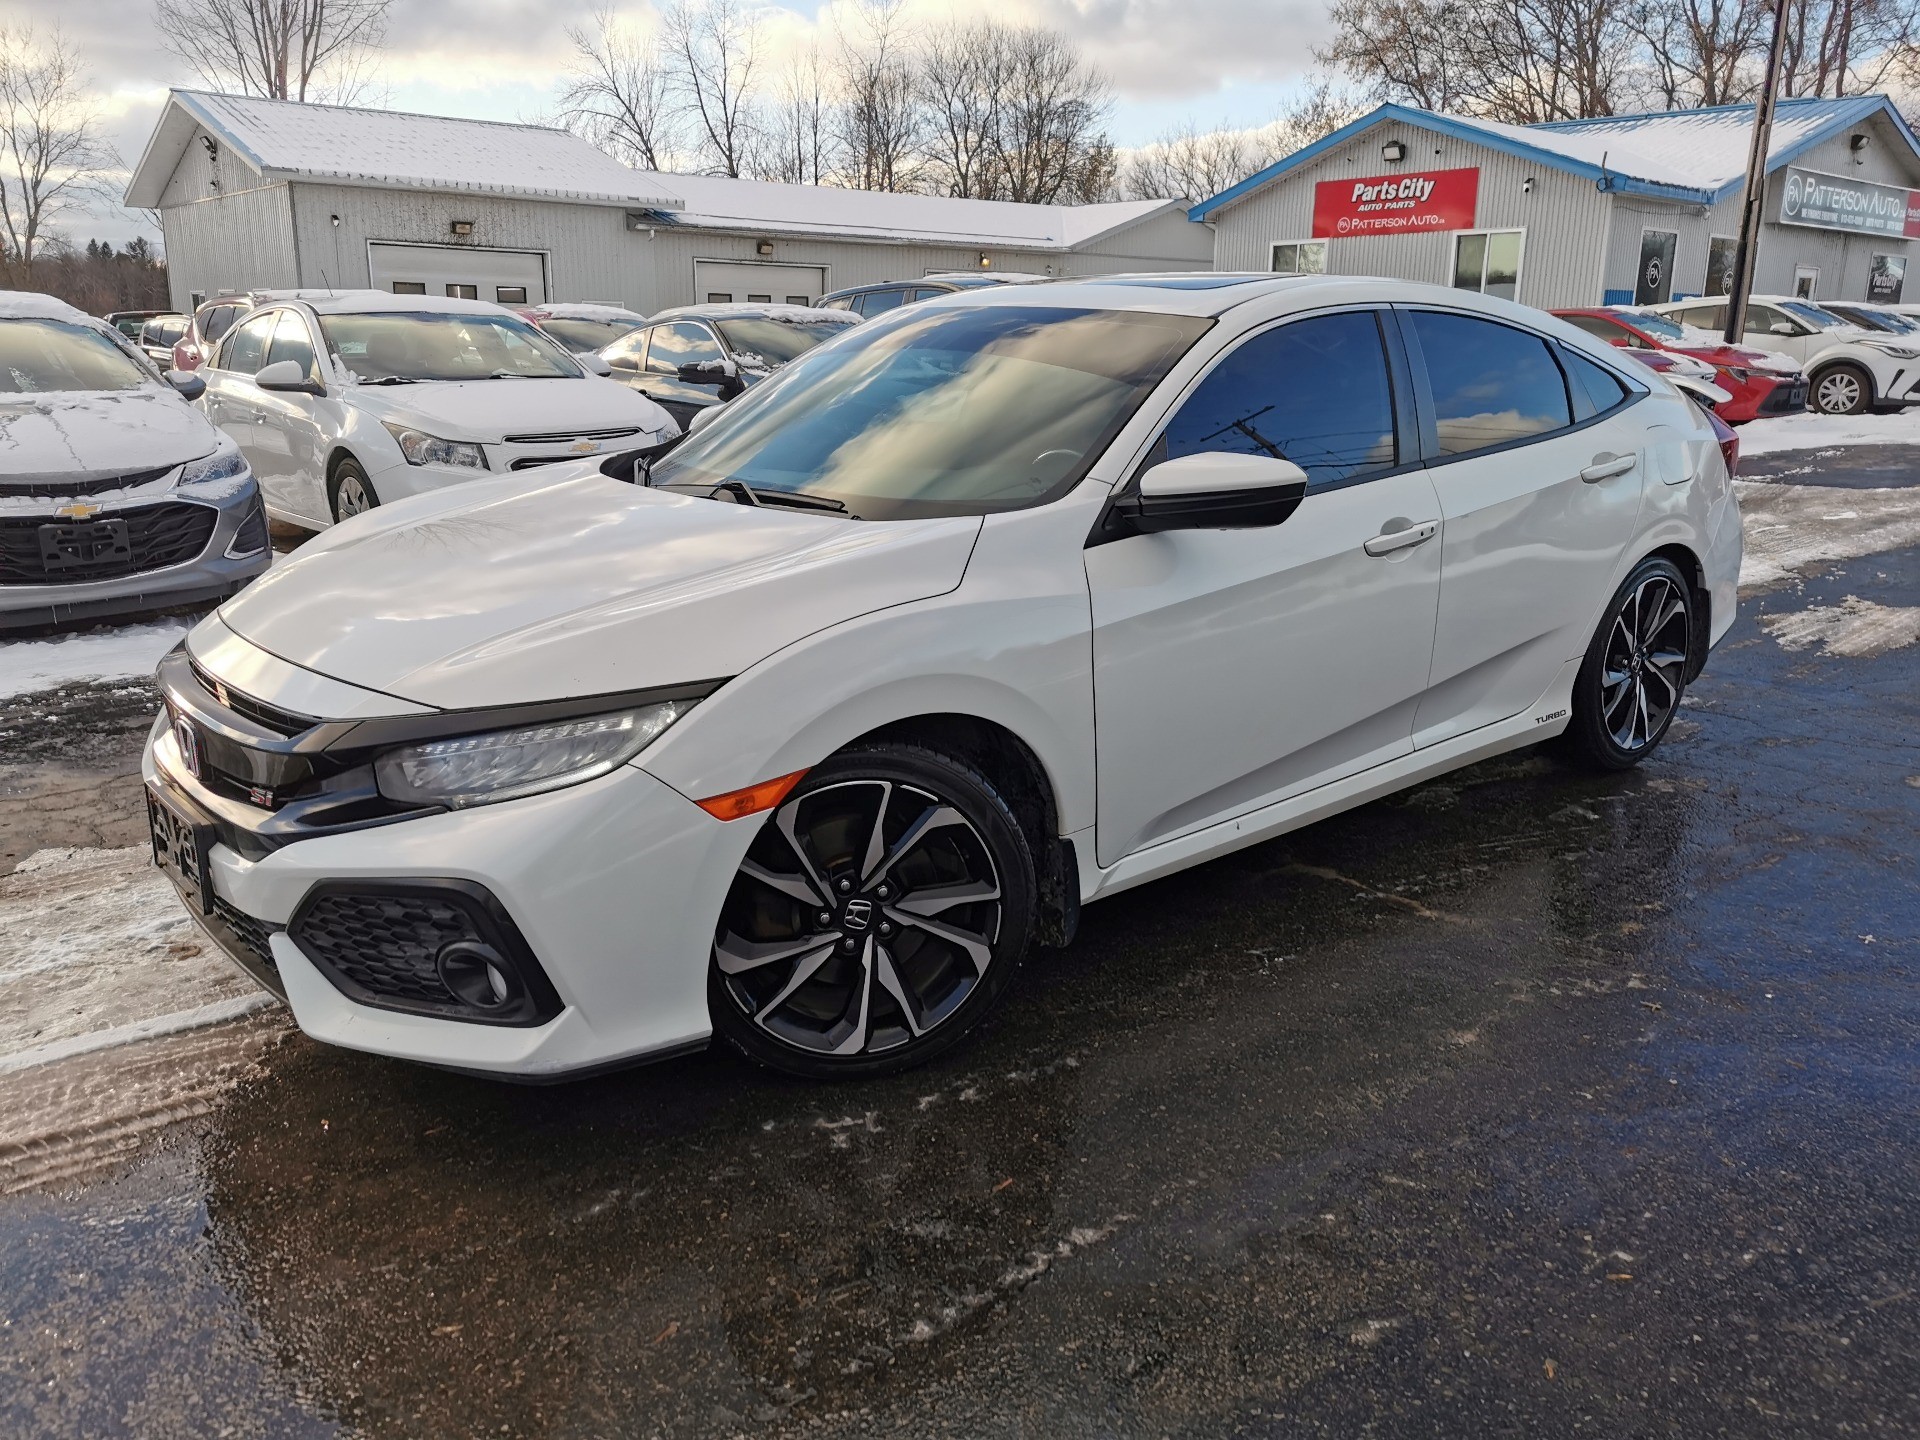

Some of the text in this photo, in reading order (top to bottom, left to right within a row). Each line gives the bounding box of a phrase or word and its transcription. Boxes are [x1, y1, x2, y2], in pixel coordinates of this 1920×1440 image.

[1804, 177, 1870, 213] PATTERSON
[1357, 200, 1416, 212] AUTO PARTS
[1351, 217, 1407, 230] PATTERSON
[1535, 709, 1567, 724] TURBO
